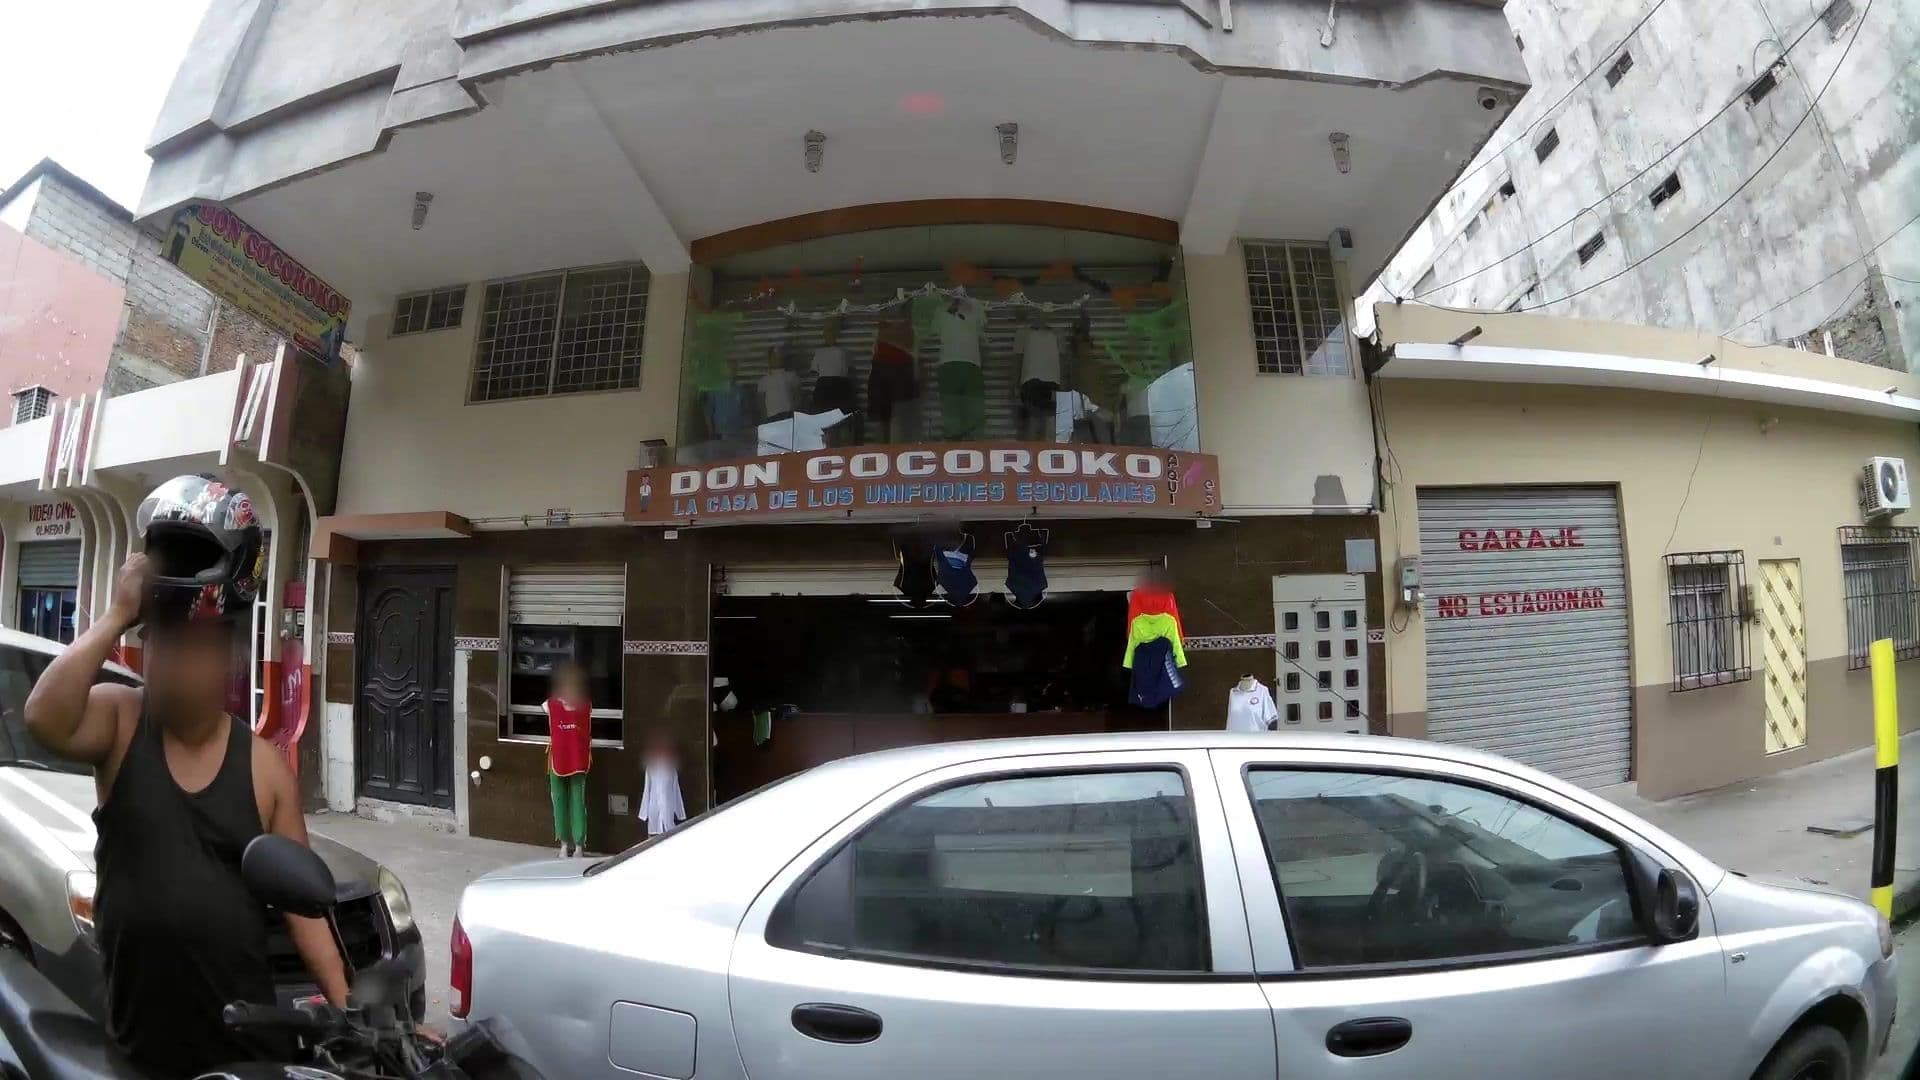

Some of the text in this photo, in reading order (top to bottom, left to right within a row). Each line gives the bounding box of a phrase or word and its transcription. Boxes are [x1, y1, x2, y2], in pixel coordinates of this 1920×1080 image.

[197, 205, 244, 248] DON
[670, 449, 1163, 496] DON COCOROKO
[1167, 453, 1179, 506] AQUI
[29, 501, 76, 522] VIDEO CINE
[673, 497, 698, 516] LA
[707, 493, 759, 513] CASA
[769, 490, 798, 510] DE
[808, 486, 854, 507] LOS
[1016, 481, 1156, 504] ESCOLARES
[1458, 526, 1585, 551] GARAJE
[1437, 588, 1605, 618] NO ESTACIONAR
